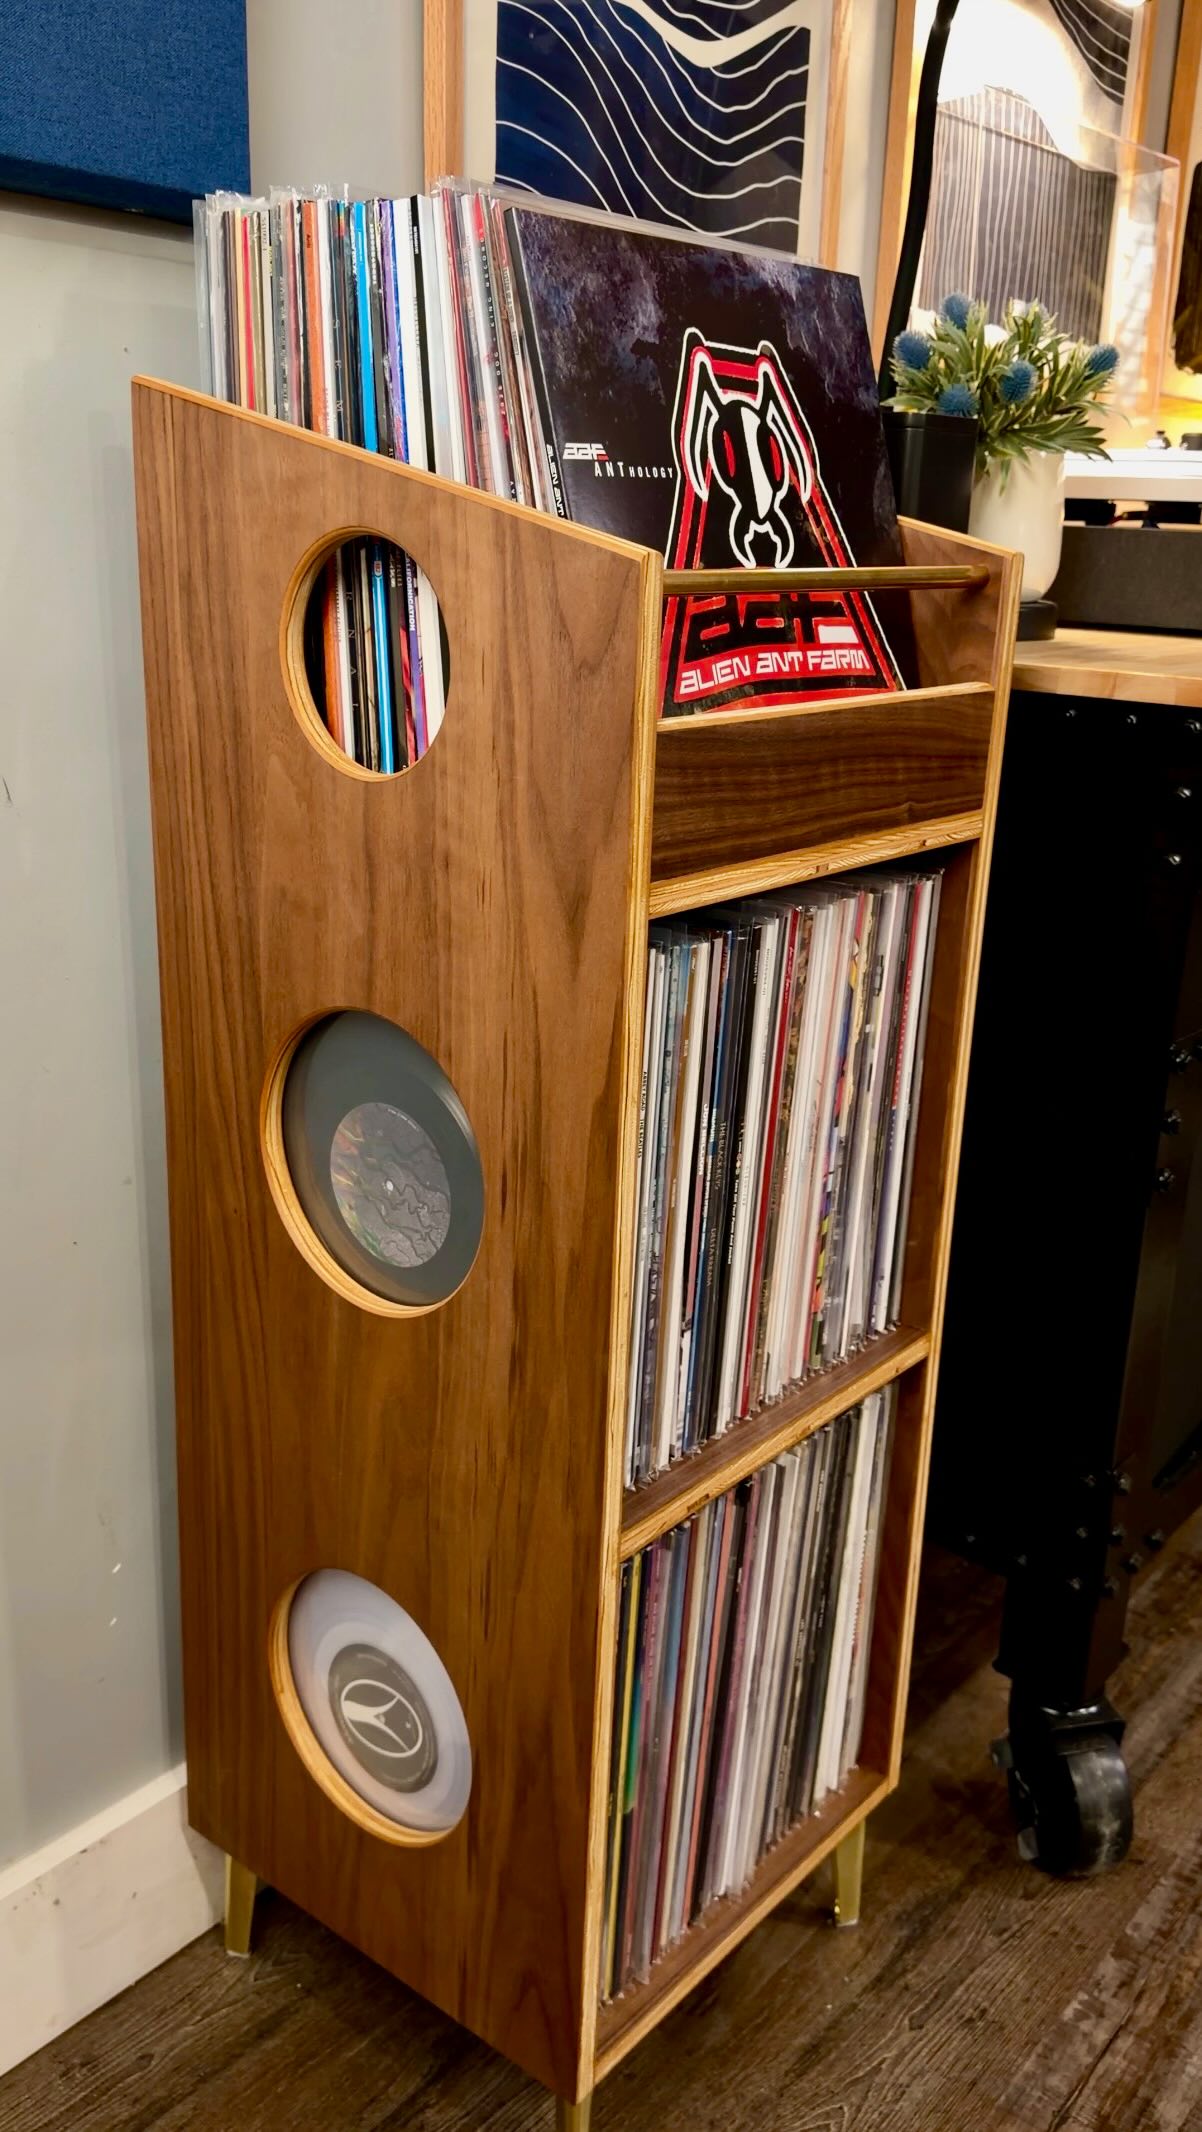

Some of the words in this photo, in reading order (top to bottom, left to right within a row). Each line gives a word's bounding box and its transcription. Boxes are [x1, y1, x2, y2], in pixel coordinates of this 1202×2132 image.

[547, 444, 558, 484] ALIEN
[555, 487, 564, 515] ANT
[405, 557, 416, 631] ALIFORNICATION
[679, 655, 751, 695] ALIEN
[756, 651, 801, 675] ANT
[808, 648, 870, 671] FARM
